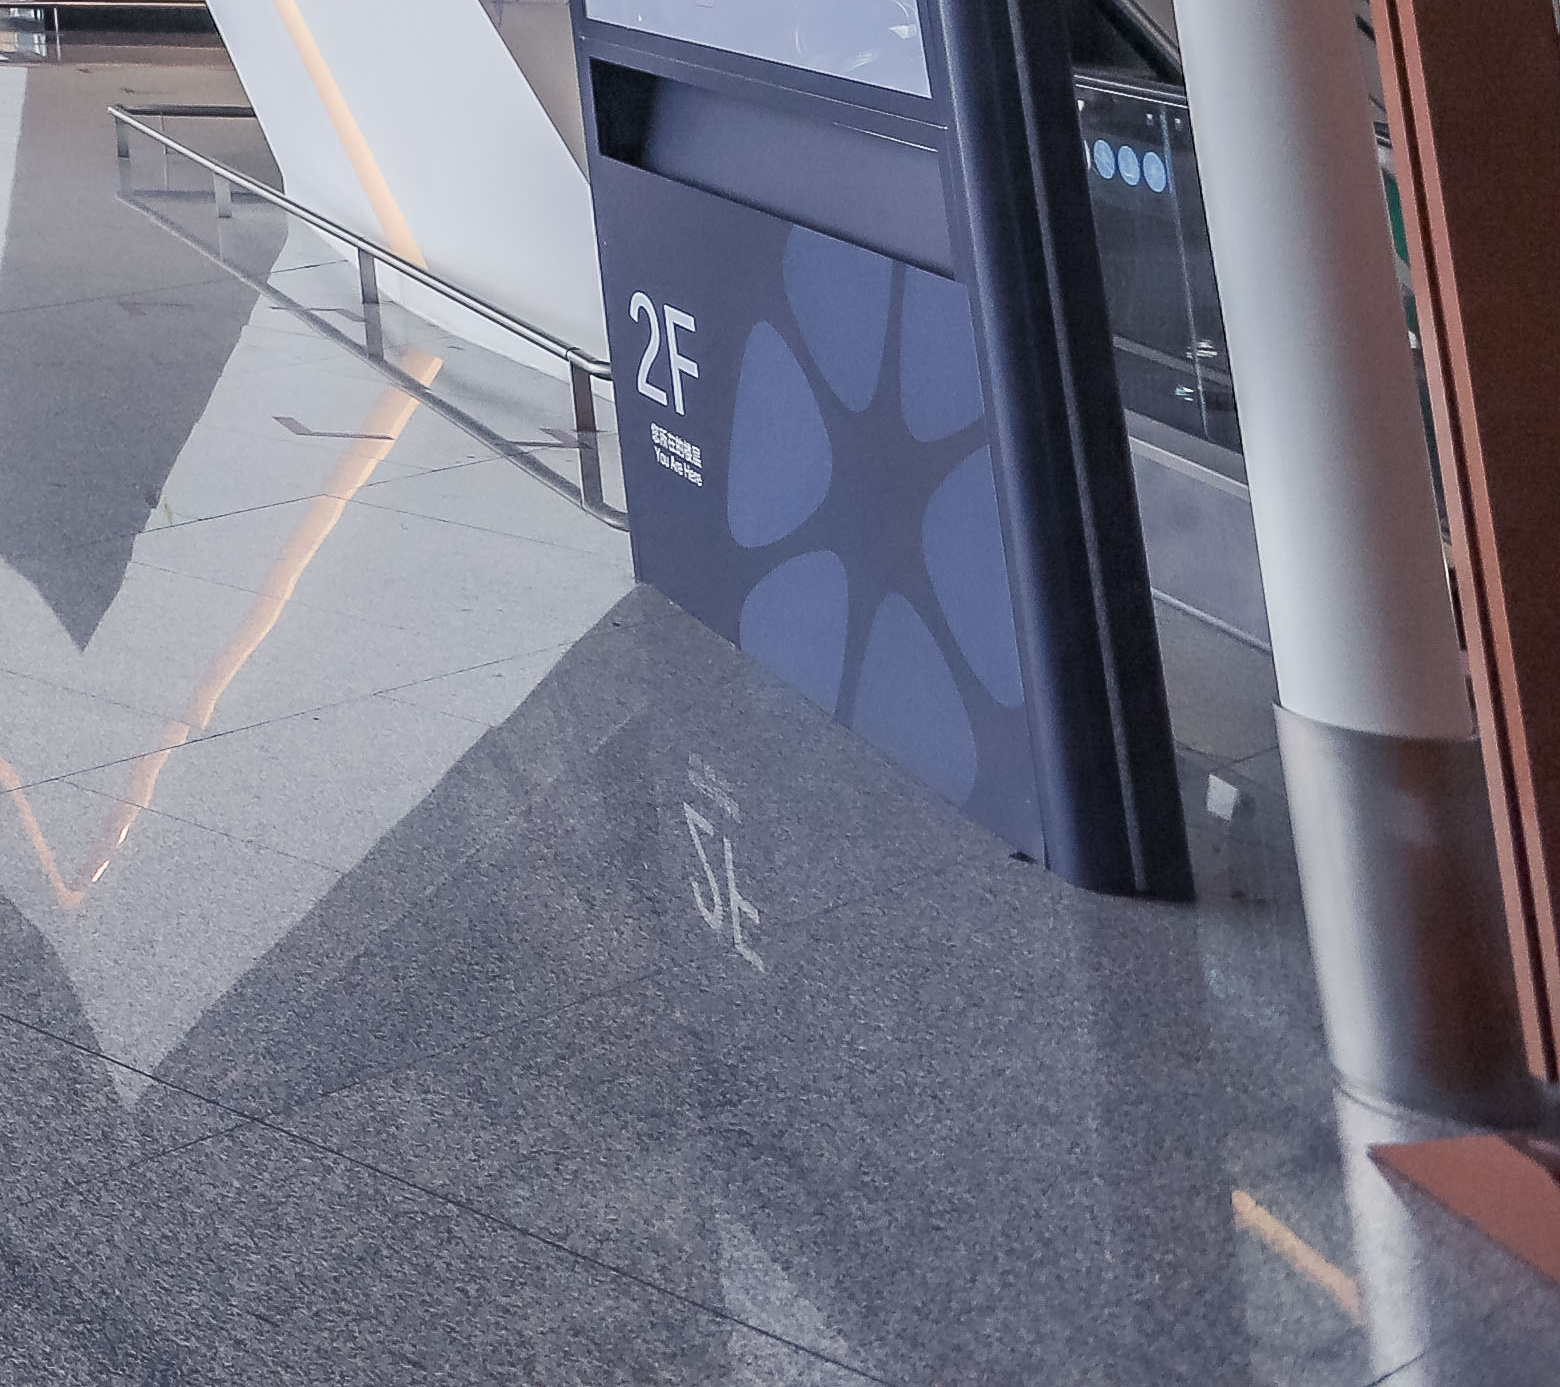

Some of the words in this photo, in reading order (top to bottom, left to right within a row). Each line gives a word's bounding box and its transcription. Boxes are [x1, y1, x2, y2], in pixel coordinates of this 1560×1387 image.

[629, 290, 700, 416] 2F
[653, 445, 670, 467] You
[670, 455, 684, 475] Are
[683, 462, 703, 487] Here
